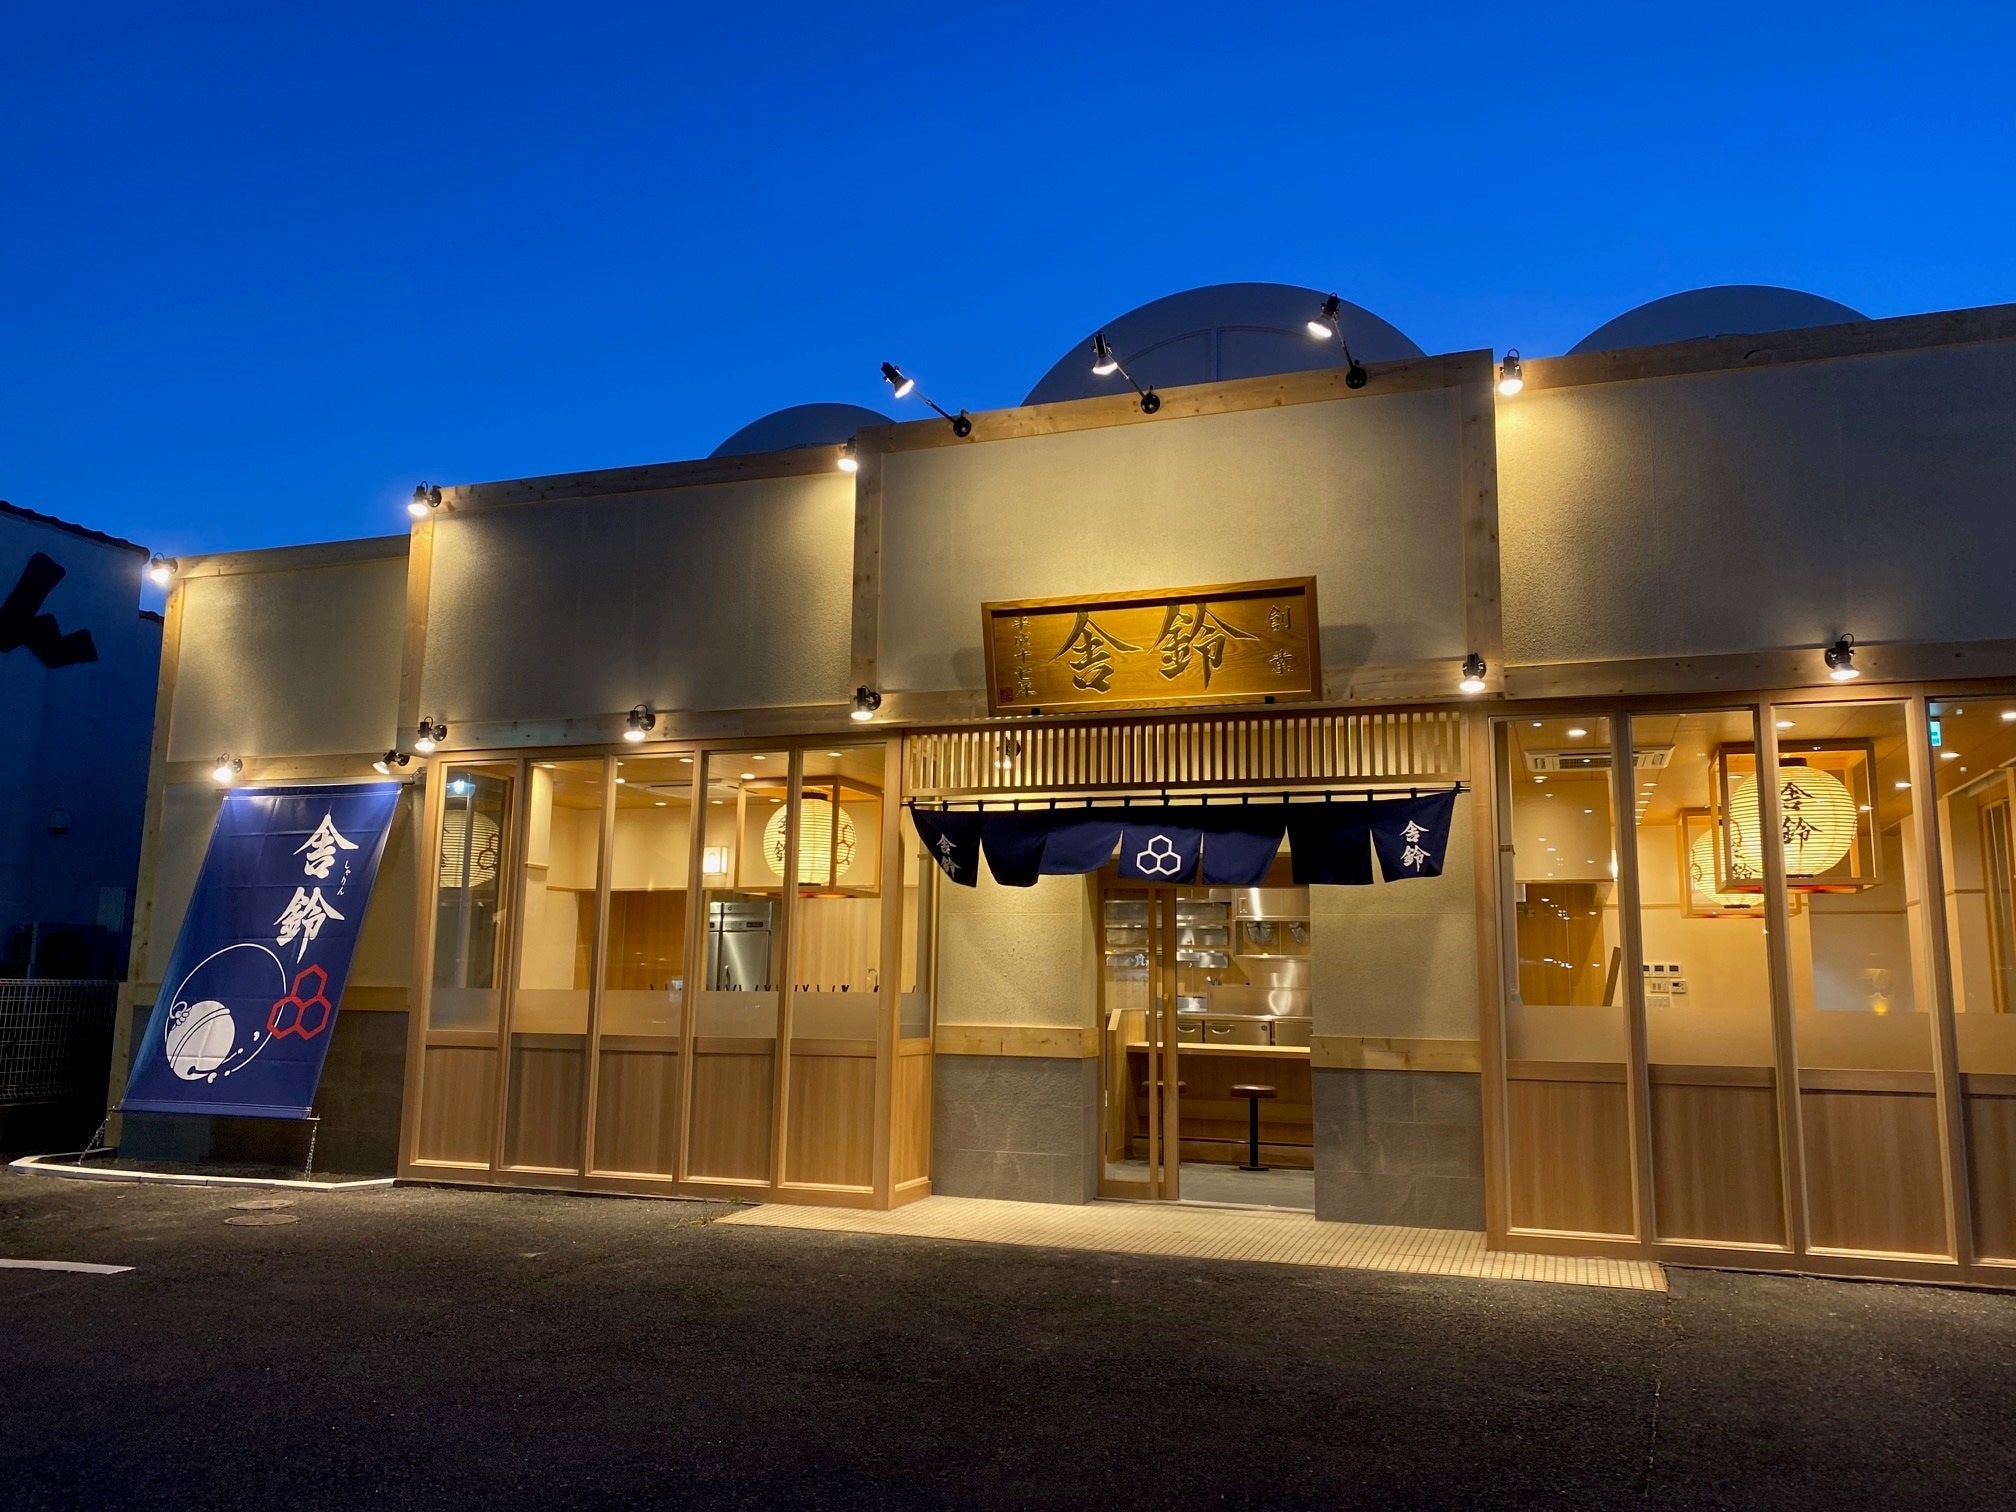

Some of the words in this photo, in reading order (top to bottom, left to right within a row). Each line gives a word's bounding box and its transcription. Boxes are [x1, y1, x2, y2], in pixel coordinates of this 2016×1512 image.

[1048, 600, 1261, 694] 舎鈴
[1400, 820, 1431, 872] 舎鈴
[1780, 781, 1822, 853] 舎鈴
[273, 814, 360, 964] 舎鈴
